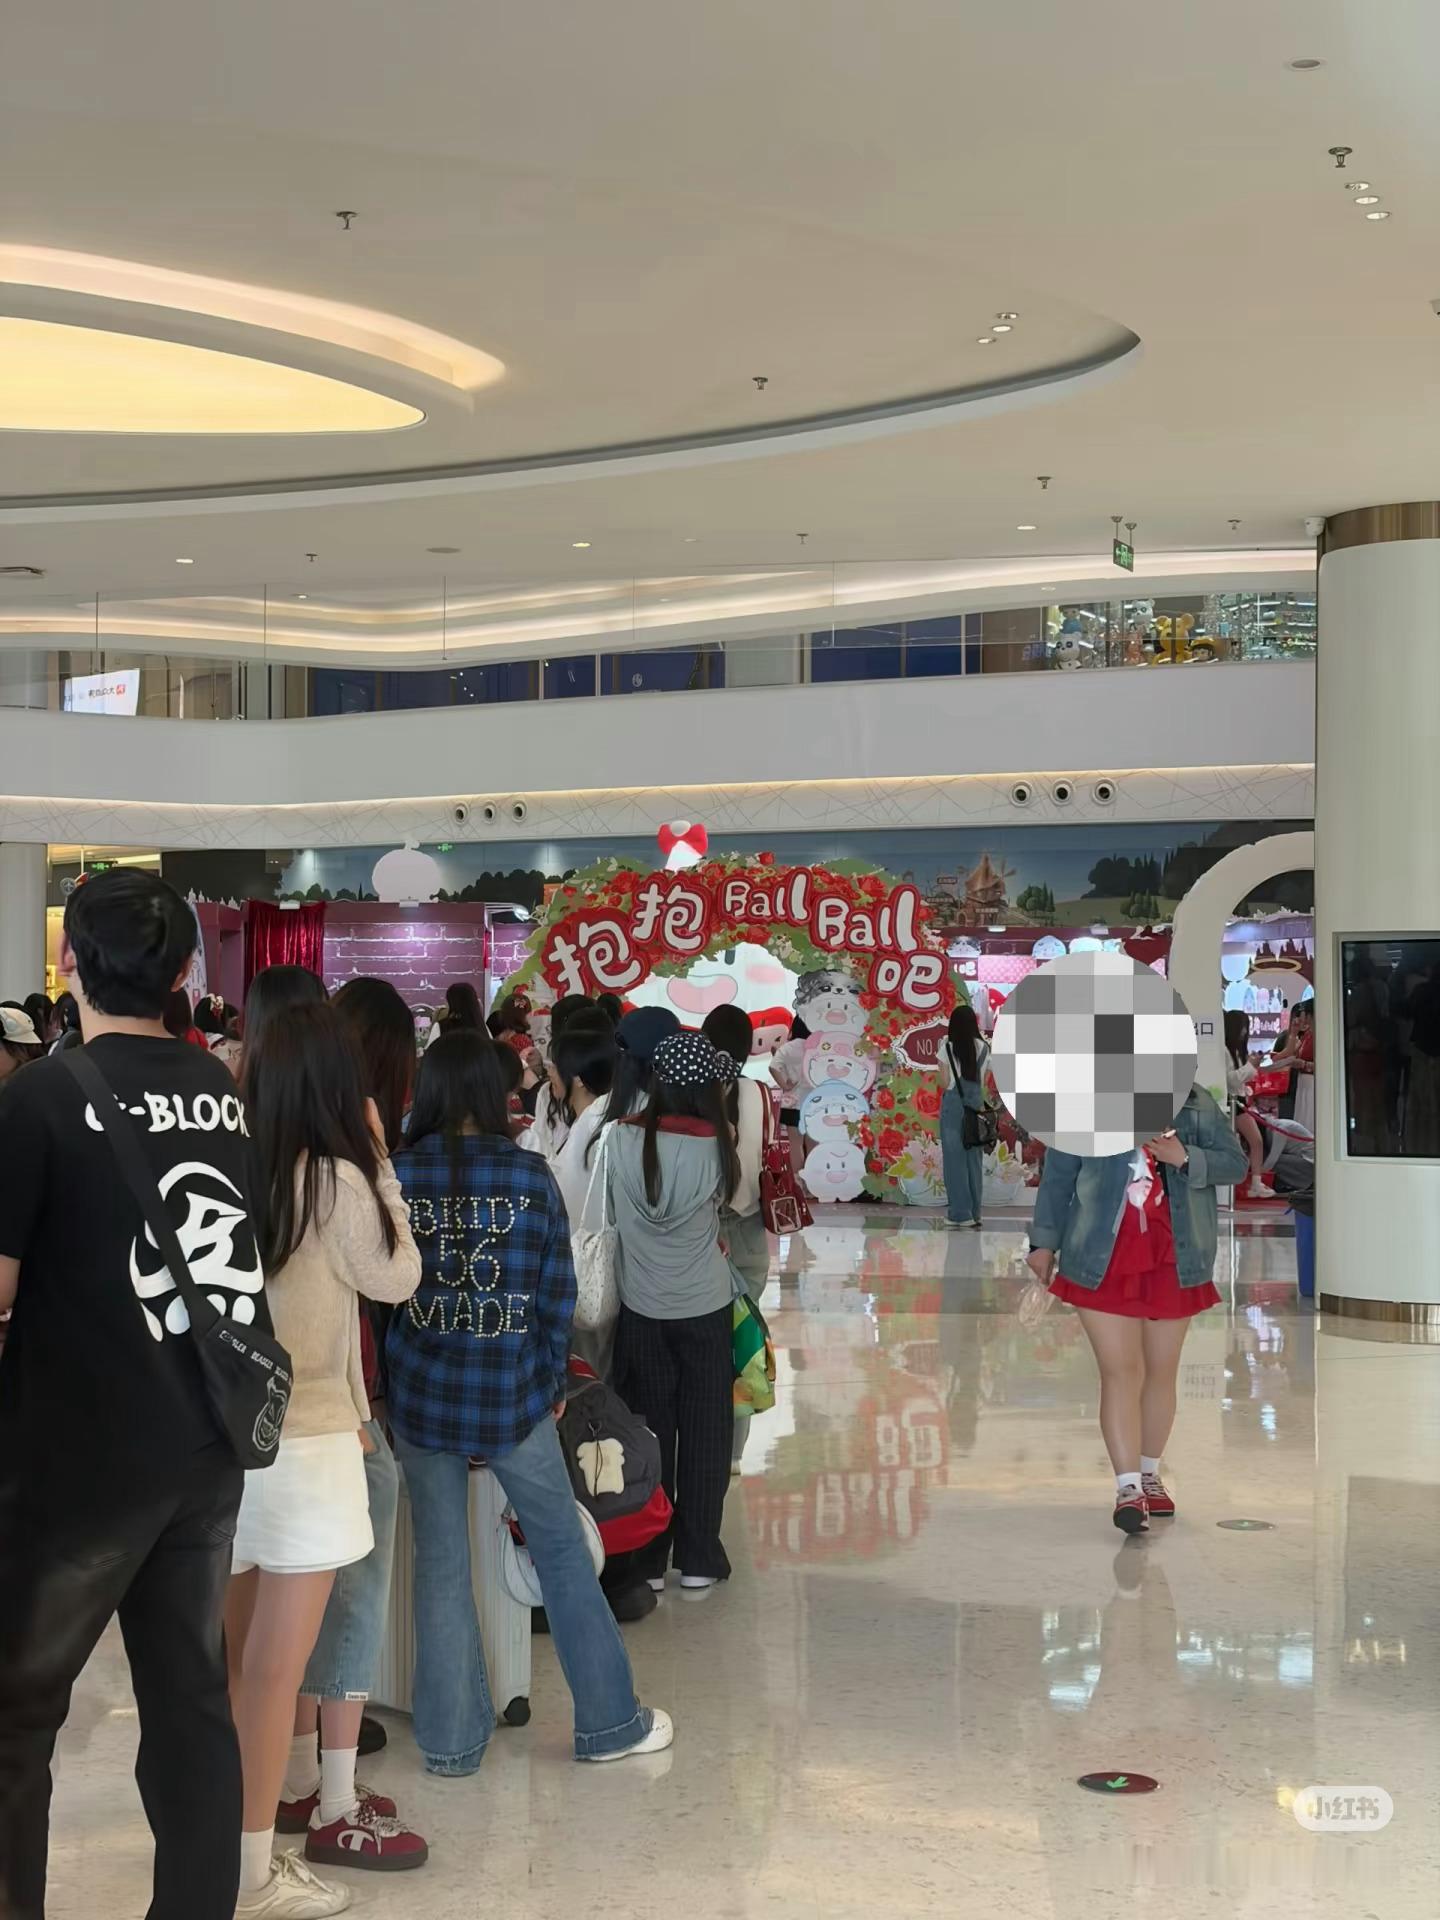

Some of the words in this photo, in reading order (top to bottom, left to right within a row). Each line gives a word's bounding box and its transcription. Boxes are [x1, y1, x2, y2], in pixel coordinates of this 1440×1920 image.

[549, 883, 704, 995] 抱抱
[725, 873, 808, 920] Ball
[818, 890, 918, 951] Ball
[876, 954, 942, 1009] 吧
[437, 1233, 501, 1291] 56
[408, 1292, 530, 1338] MADE
